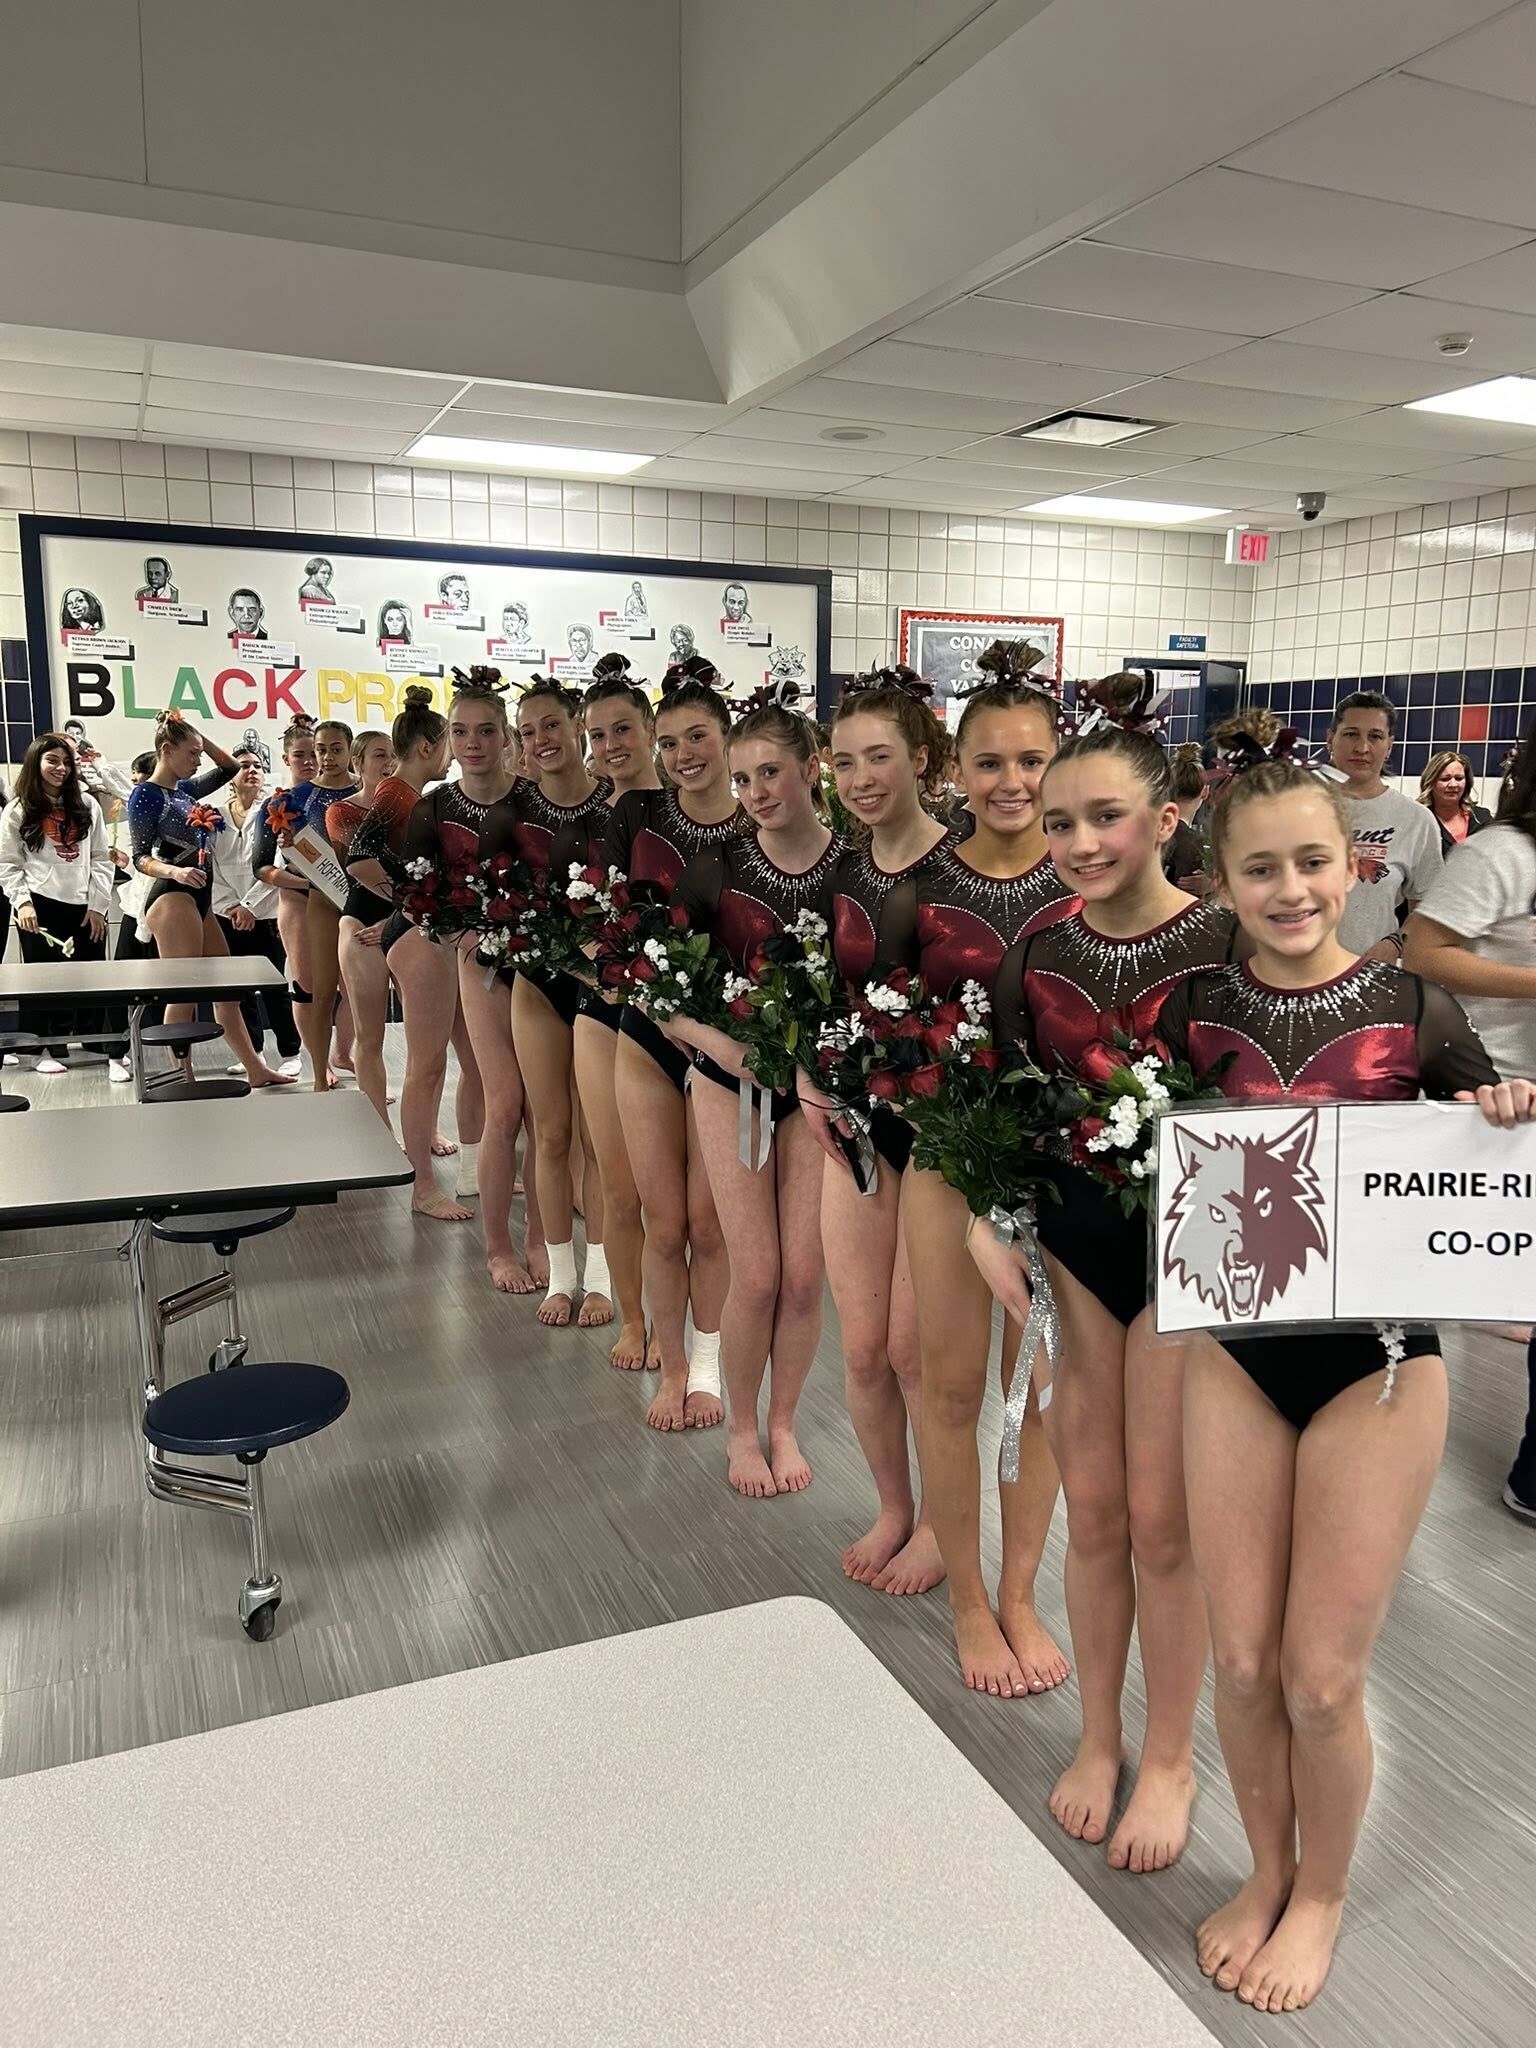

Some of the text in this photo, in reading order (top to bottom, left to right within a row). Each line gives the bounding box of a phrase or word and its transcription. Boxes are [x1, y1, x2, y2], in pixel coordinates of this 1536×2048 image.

[1240, 534, 1270, 561] EXIT
[66, 662, 307, 720] BLACK
[1364, 1172, 1536, 1199] PRAIRIE-RI
[1428, 1230, 1533, 1257] CO-OP
